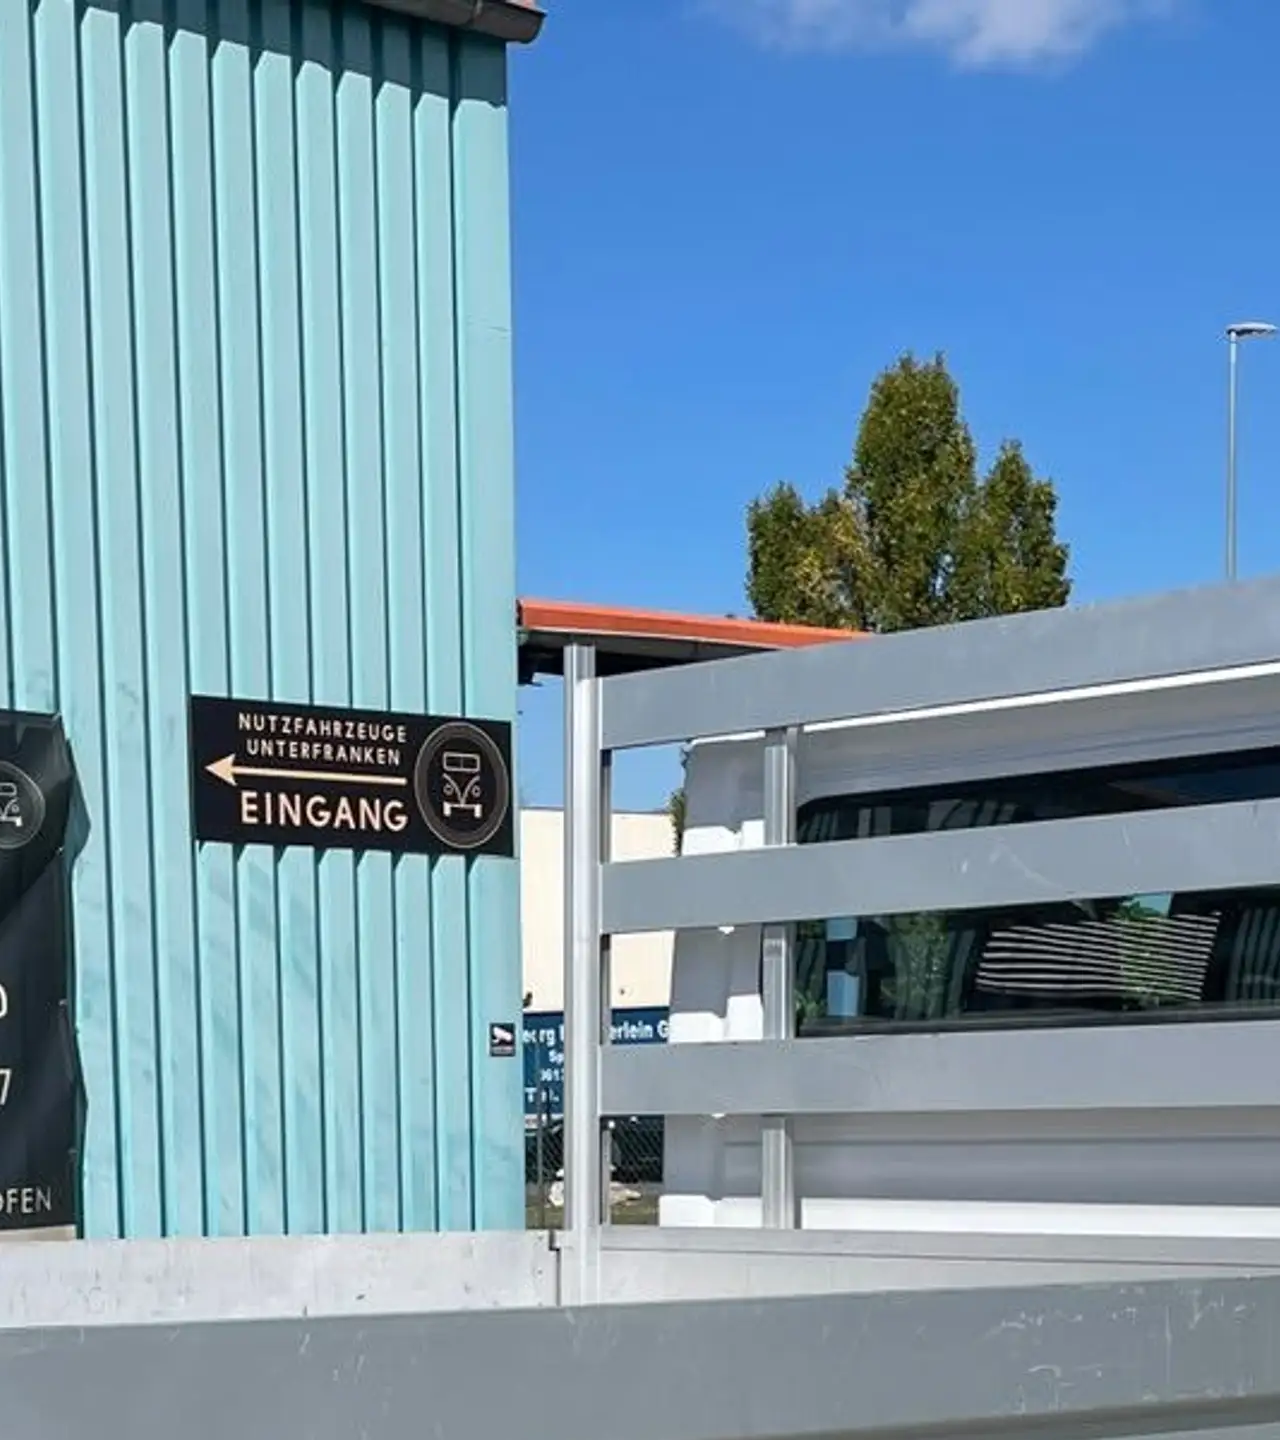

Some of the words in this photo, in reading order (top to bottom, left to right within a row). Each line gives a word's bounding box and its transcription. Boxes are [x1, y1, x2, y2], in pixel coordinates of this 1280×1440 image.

[238, 712, 407, 743] NUTZFAHRZEUGE
[246, 738, 401, 766] UNTERFRANKEN
[240, 790, 409, 832] EINGANG
